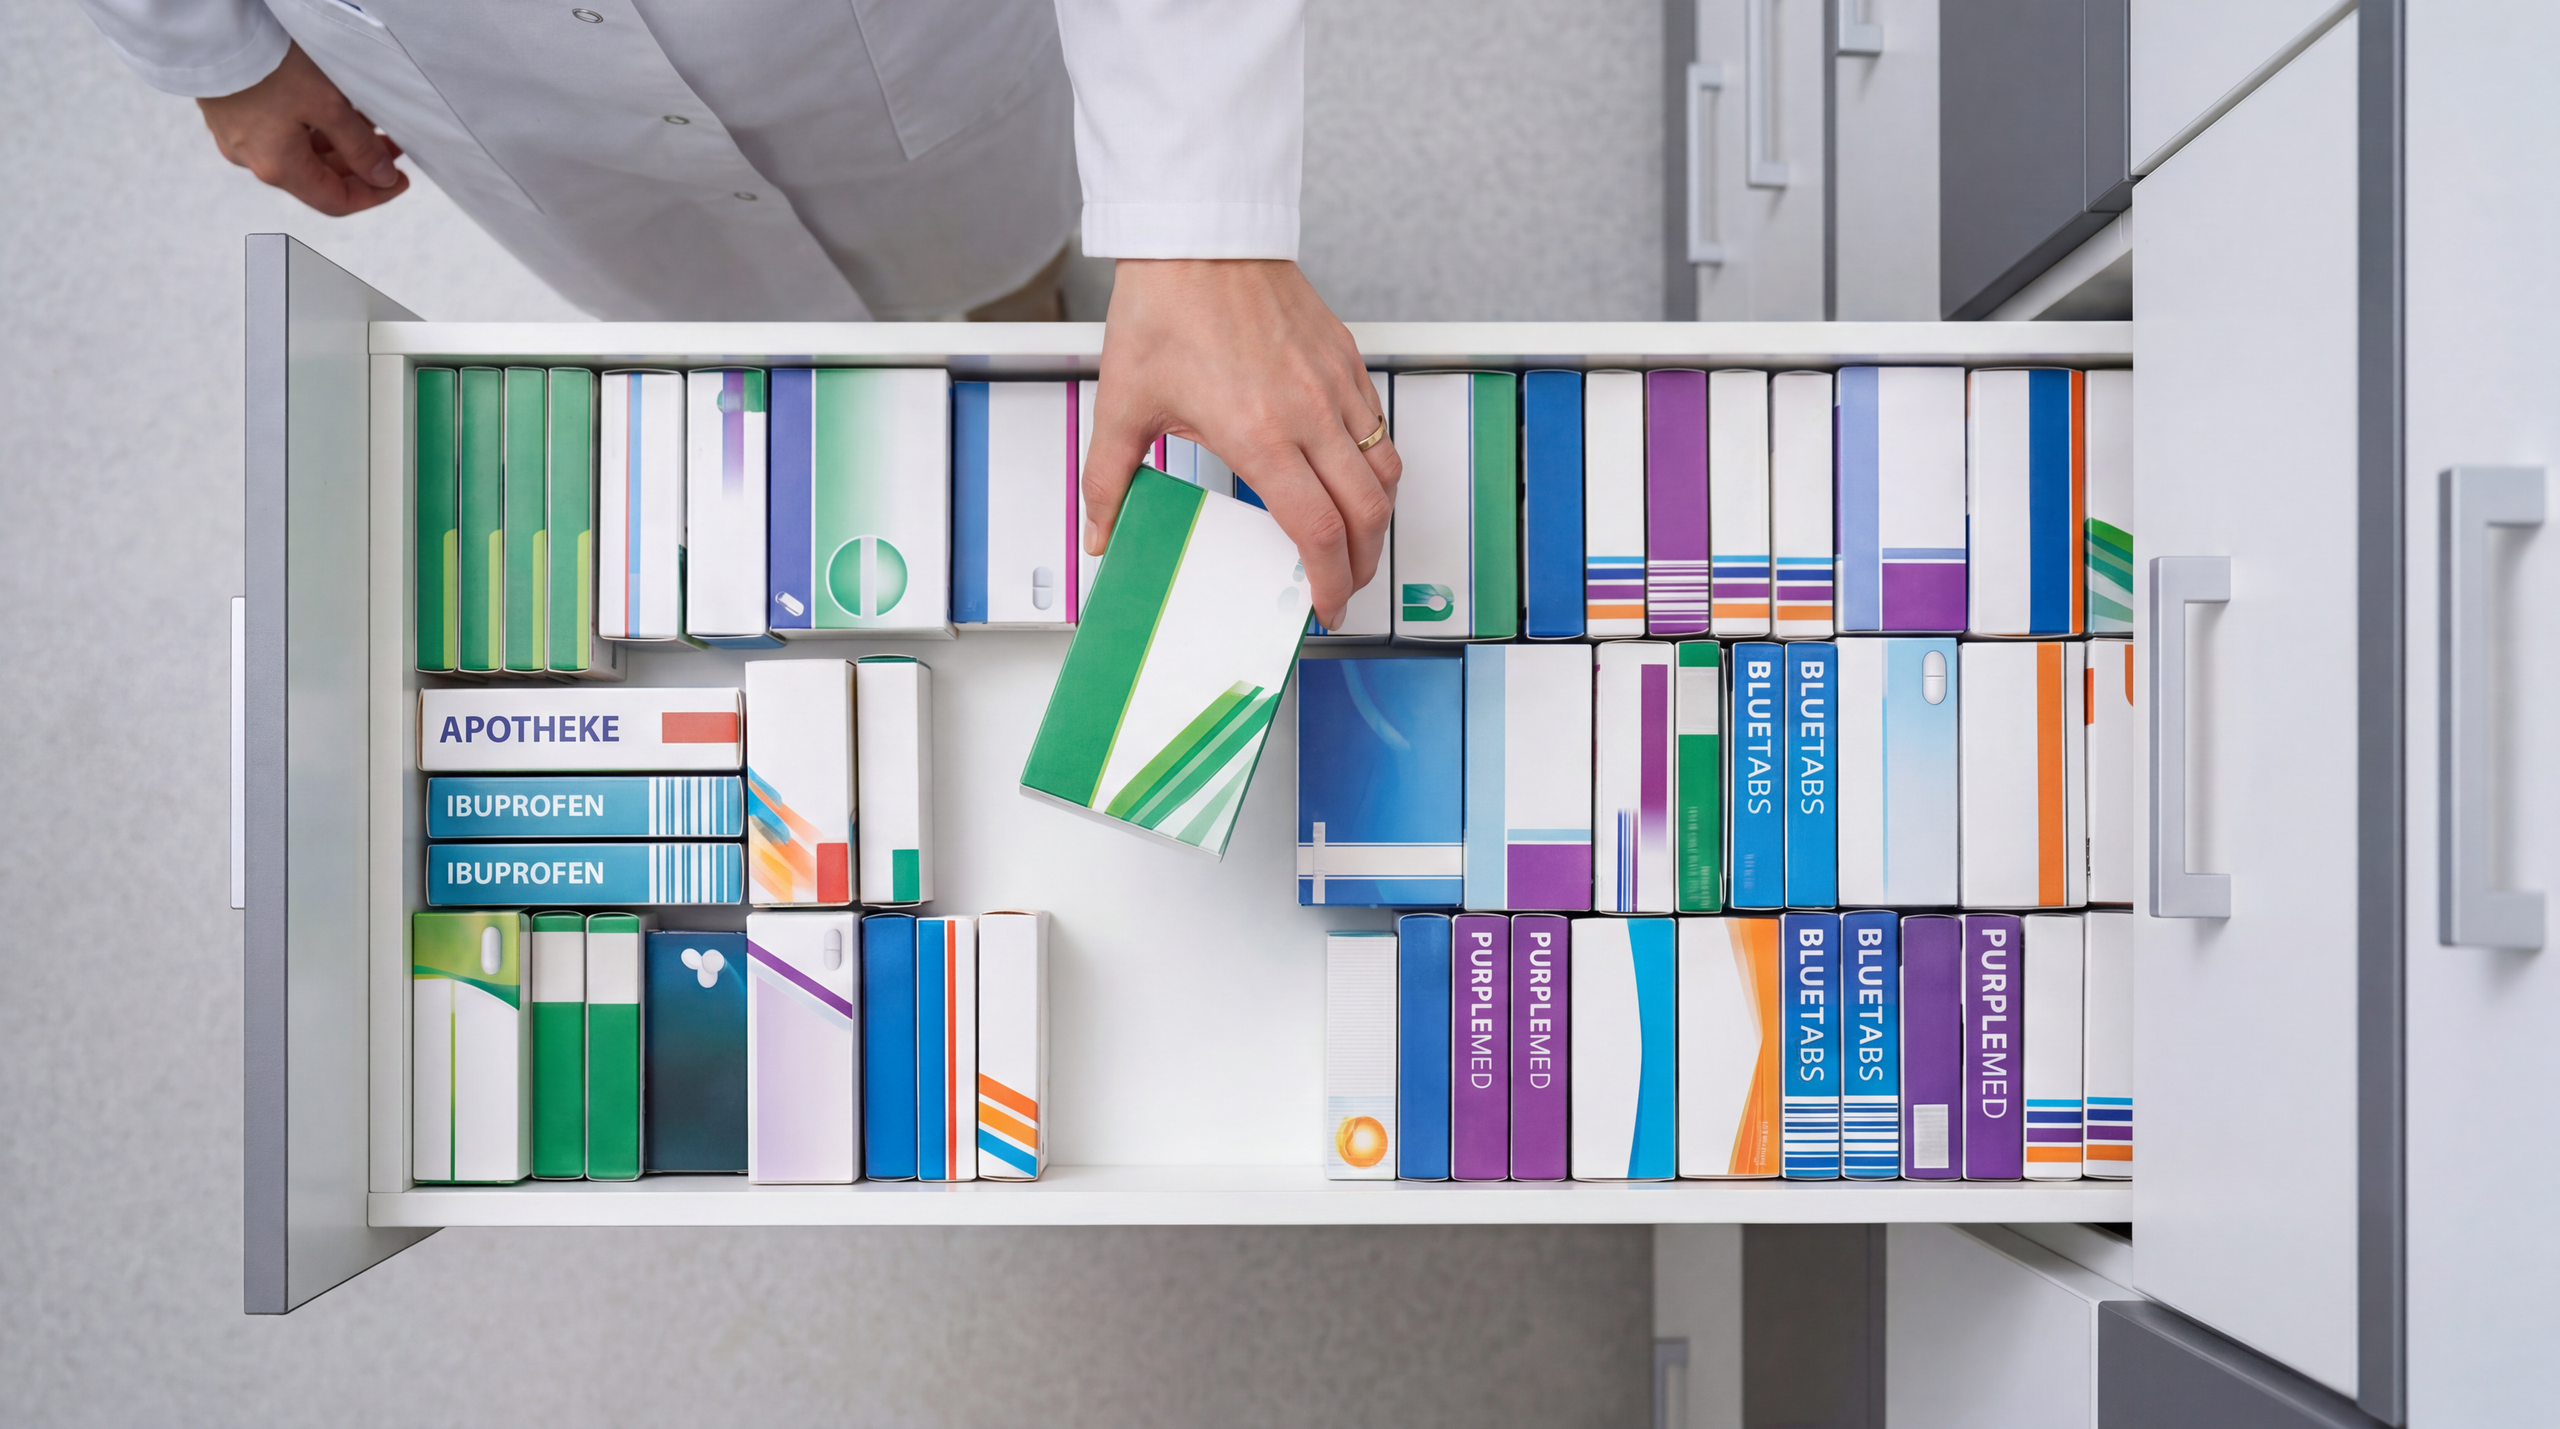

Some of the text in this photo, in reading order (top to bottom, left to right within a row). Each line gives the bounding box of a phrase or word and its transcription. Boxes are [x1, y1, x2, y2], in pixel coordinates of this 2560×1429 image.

[439, 715, 620, 743] APOTHEKE
[447, 794, 604, 818] IBUPROFEN
[1747, 660, 1772, 814] BLUETABS
[1800, 660, 1825, 815] BLUETABS
[447, 861, 604, 885] IBUPROFEN
[1470, 931, 1493, 1089] PURPLEMED
[1529, 931, 1552, 1089] PURPLEMED
[1799, 928, 1825, 1082] BLUETABS
[1857, 928, 1884, 1081] BLUETABS
[1980, 928, 2008, 1119] PURPLEMED
